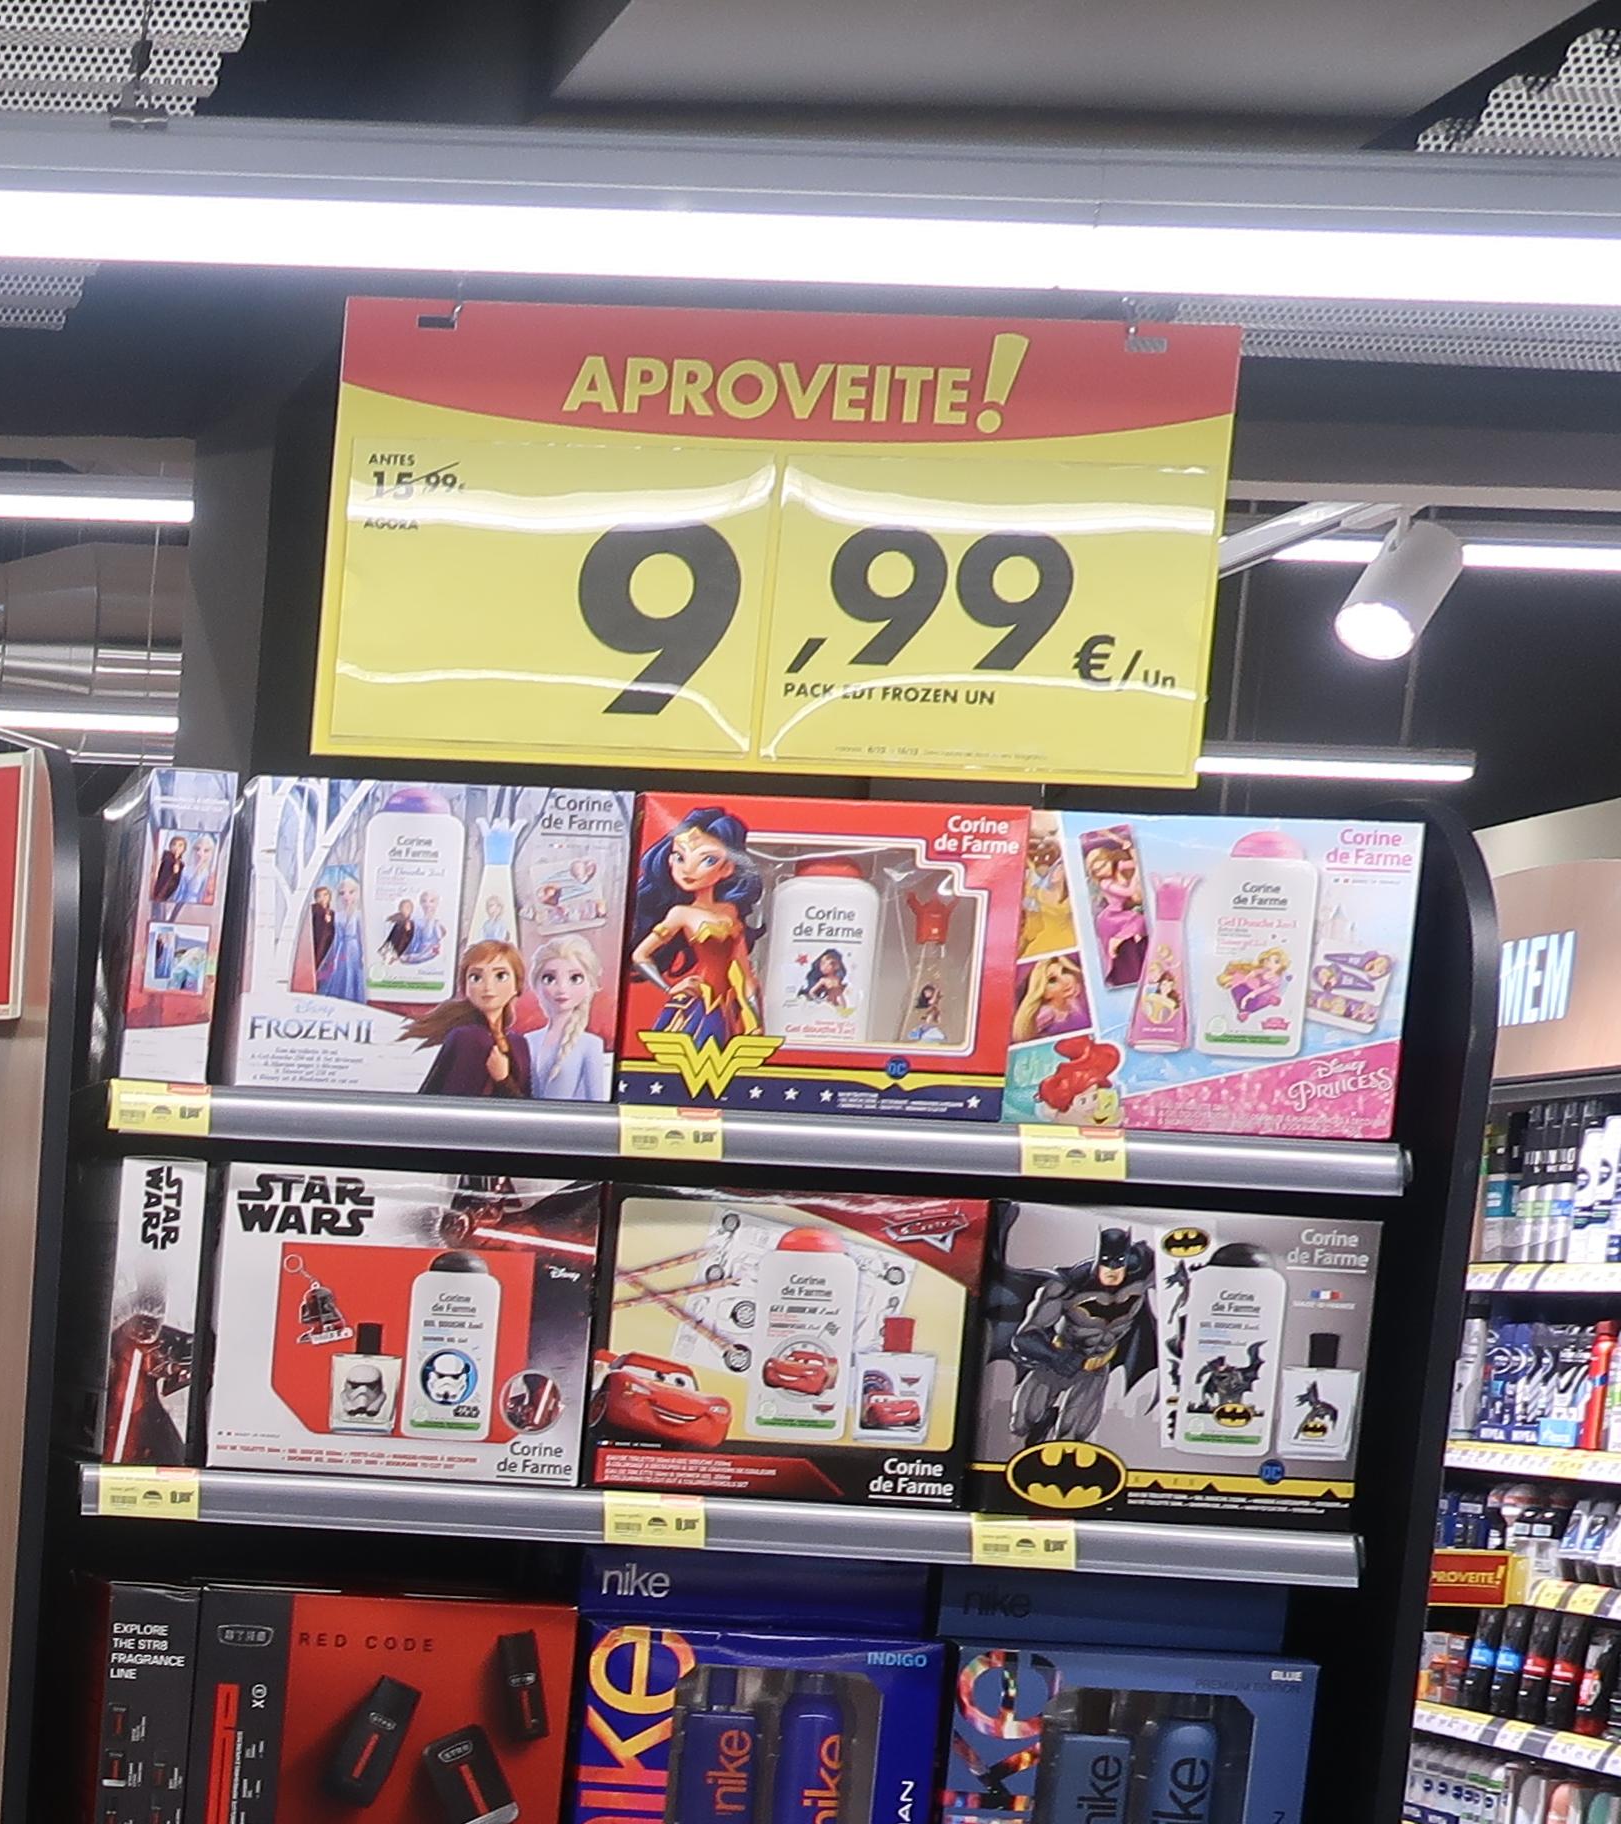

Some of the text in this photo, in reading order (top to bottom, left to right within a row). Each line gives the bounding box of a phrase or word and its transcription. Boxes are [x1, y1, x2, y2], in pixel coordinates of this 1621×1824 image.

[563, 333, 1030, 434] APROVEITE!
[368, 454, 415, 466] ANTES
[578, 521, 742, 715] 9
[784, 683, 995, 705] PACK EDT FROZEN UN
[555, 795, 612, 812] Corine
[541, 815, 623, 832] de Farme
[948, 816, 1008, 834] Corine
[934, 834, 1019, 854] de Farme
[1341, 829, 1402, 846] Corine
[1326, 849, 1412, 866] de Farme
[1500, 931, 1577, 1028] MEM
[248, 1017, 373, 1042] FROZEN II
[1288, 1067, 1394, 1112] PRINCESS
[238, 1173, 375, 1206] STAR
[238, 1202, 373, 1237] WARS
[1301, 1229, 1359, 1246] Corine
[1287, 1248, 1369, 1267] de Farme
[602, 1564, 670, 1599] nike
[1430, 1566, 1505, 1587] PROVEITE!
[113, 1623, 169, 1637] EXPLORE
[113, 1637, 168, 1652] THE STR8
[299, 1633, 435, 1652] RED CODE
[111, 1652, 185, 1668] FRAGRANCE
[868, 1651, 928, 1668] INDIGO
[110, 1668, 137, 1680] LINE
[1271, 1669, 1303, 1682] BLUE
